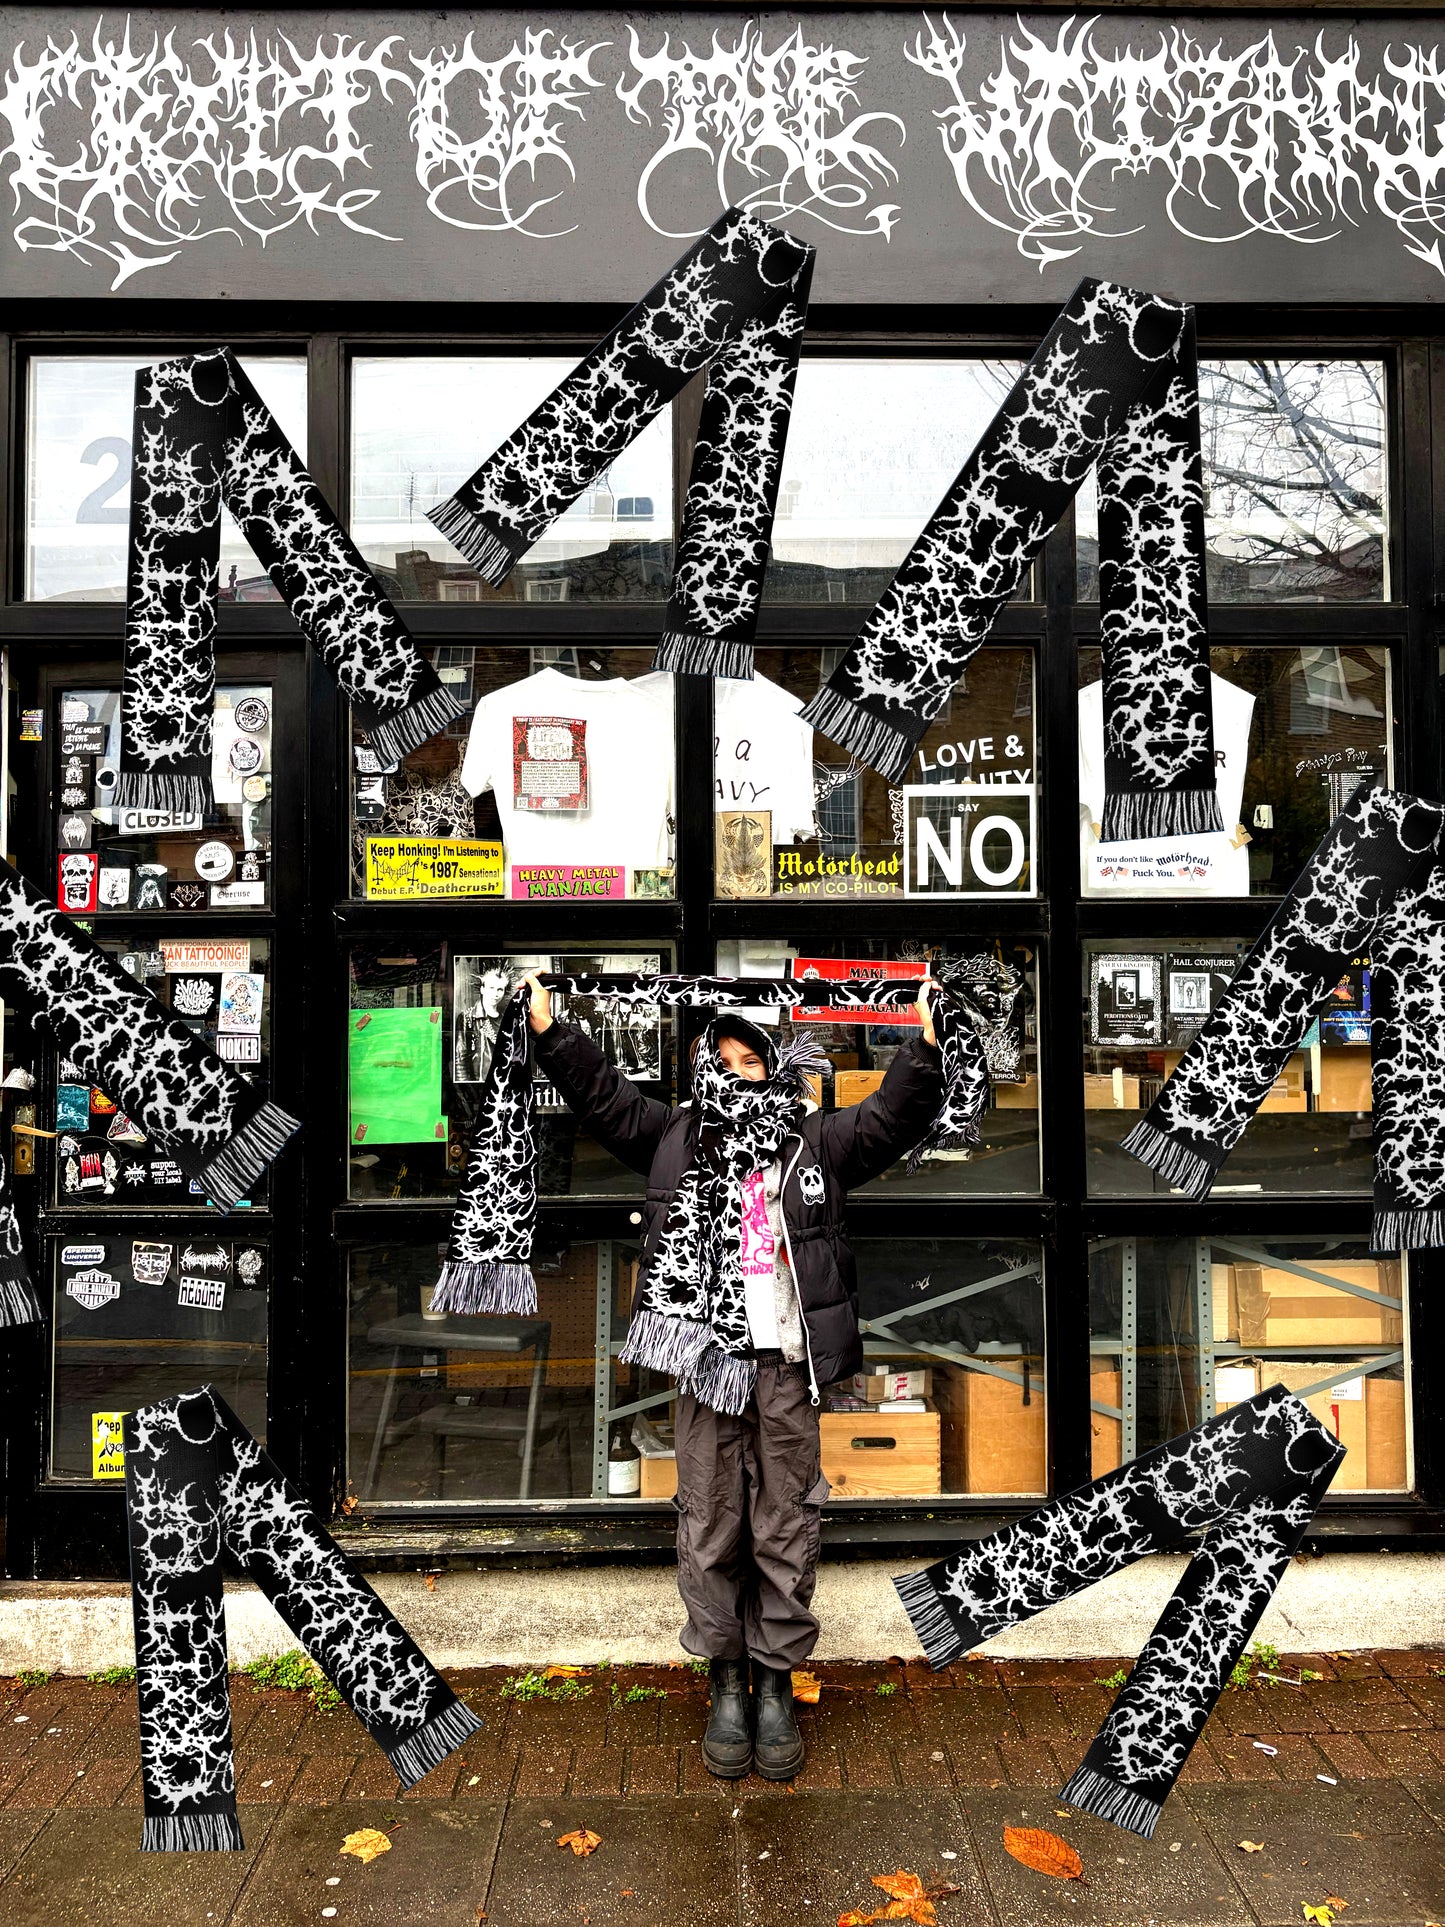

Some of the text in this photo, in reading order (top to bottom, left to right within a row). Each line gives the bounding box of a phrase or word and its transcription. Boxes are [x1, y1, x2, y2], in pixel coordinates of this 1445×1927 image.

[918, 734, 1025, 772] LOVE &
[958, 804, 980, 812] SAY
[125, 811, 196, 829] CLOSED
[370, 843, 499, 859] Keep Honking! I'm Listening to
[916, 815, 1025, 886] NO
[430, 862, 458, 878] 1987
[459, 868, 500, 878] Sensational
[778, 851, 900, 881] Motörhead
[1132, 869, 1175, 877] Fuck You.
[519, 867, 619, 882] HEAVY METAL
[371, 887, 396, 895] Debut
[400, 887, 415, 895] E.P.
[528, 880, 611, 898] MANIAC!
[780, 882, 899, 894] IS MY CO-PILOT
[161, 947, 249, 960] BAN TATTOOING!!
[1194, 959, 1236, 968] CONJURER
[849, 967, 888, 979] MAKE
[867, 1004, 908, 1014] AGAIN
